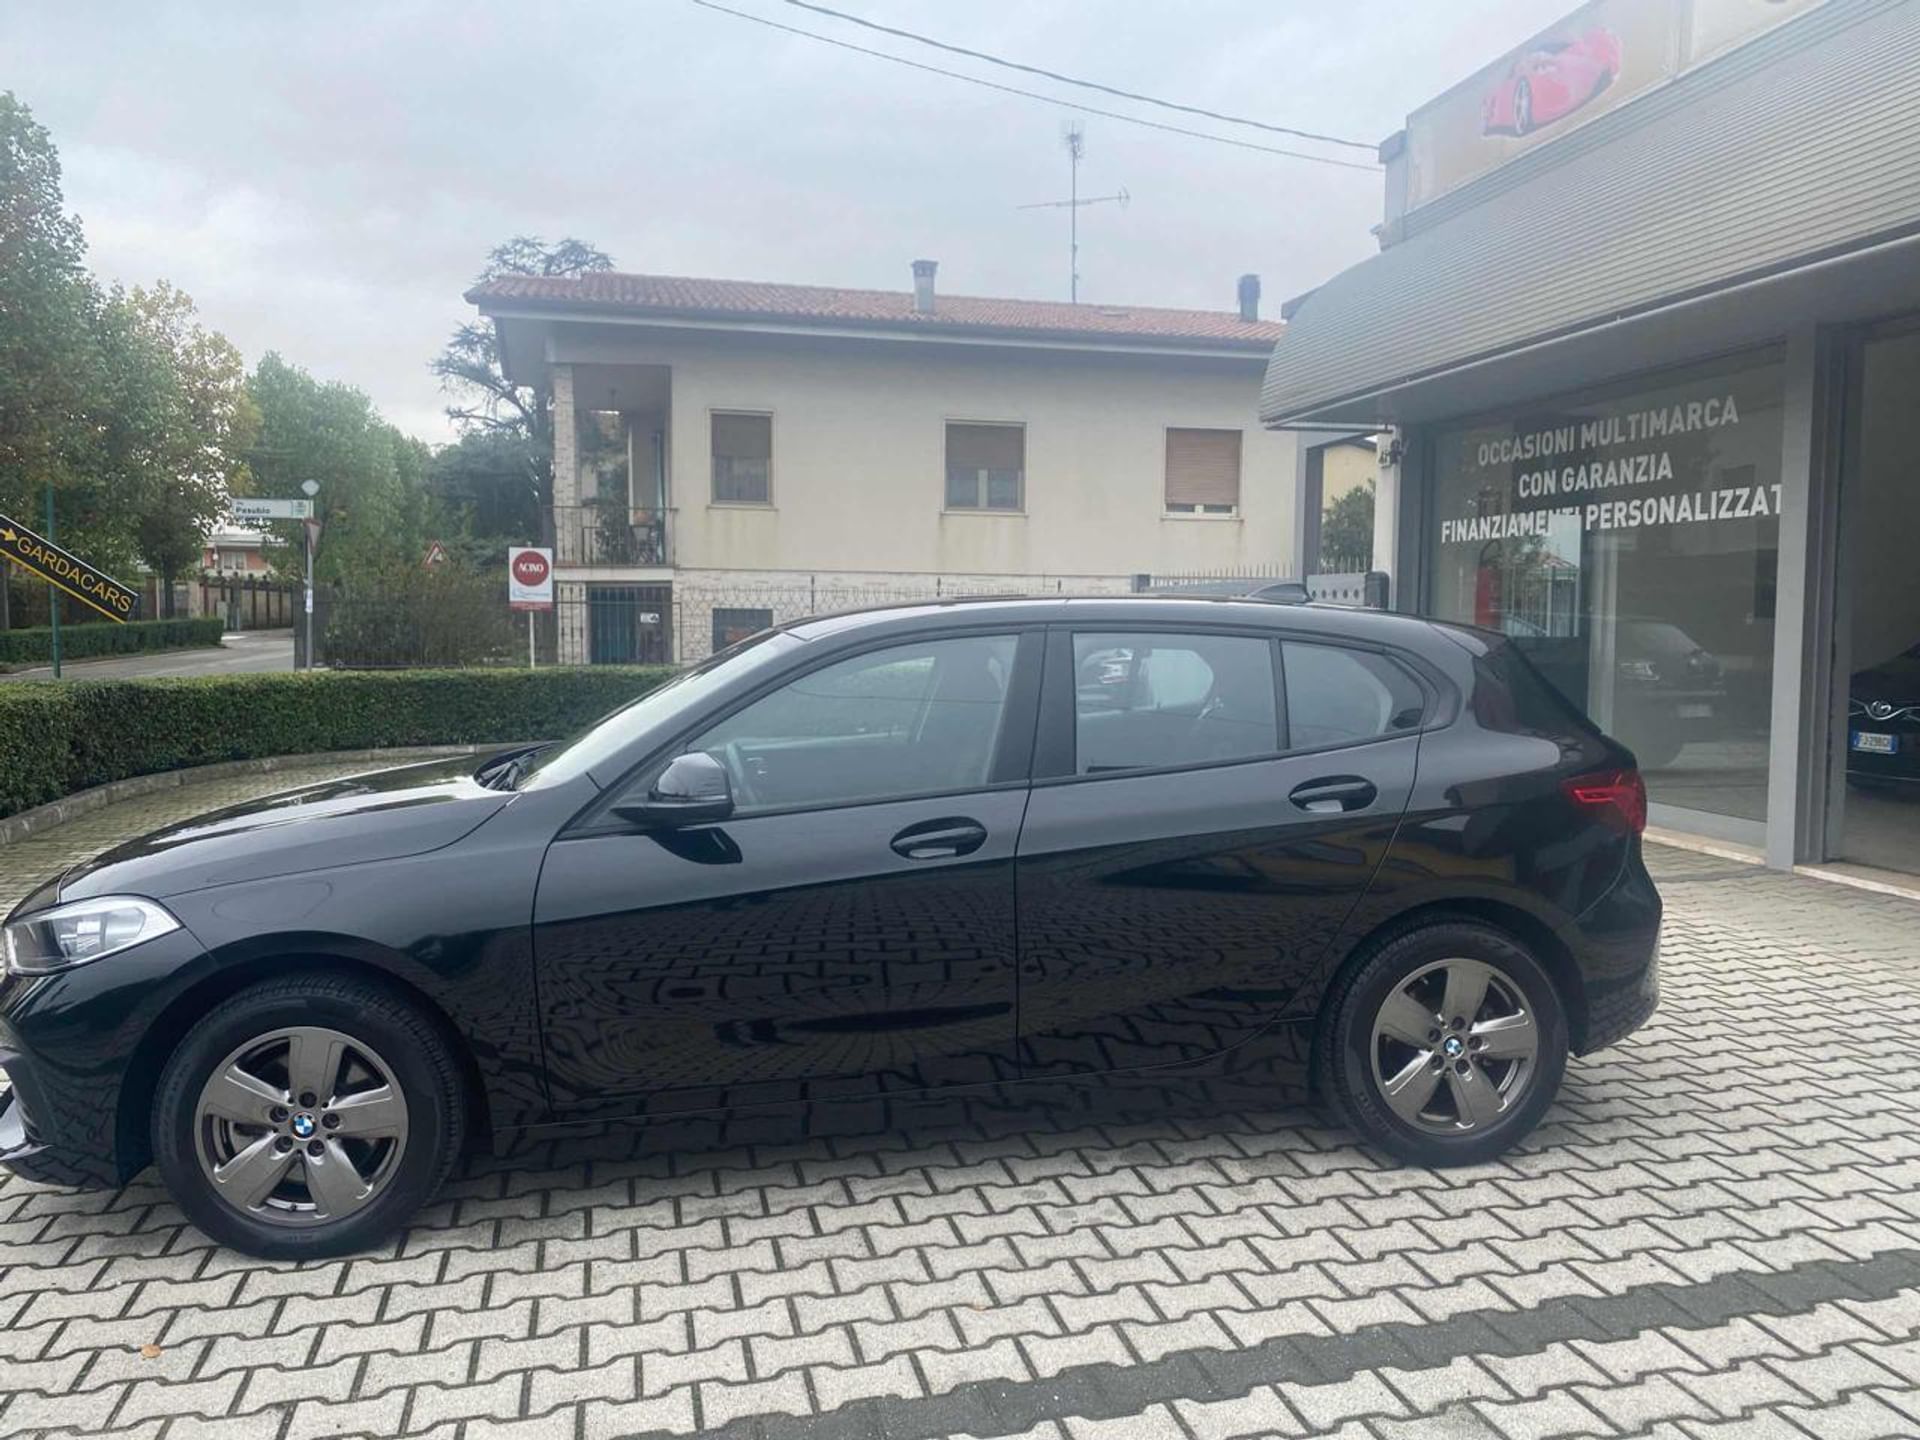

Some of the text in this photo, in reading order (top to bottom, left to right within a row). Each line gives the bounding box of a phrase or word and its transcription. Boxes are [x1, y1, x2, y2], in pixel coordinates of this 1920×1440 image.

[1478, 395, 1739, 467] OCCASIONI MULTIMARCA
[1518, 452, 1673, 498] CON GARANZIA
[1441, 506, 1580, 544] FINANZIAMEN
[17, 536, 131, 612] GARDACARS
